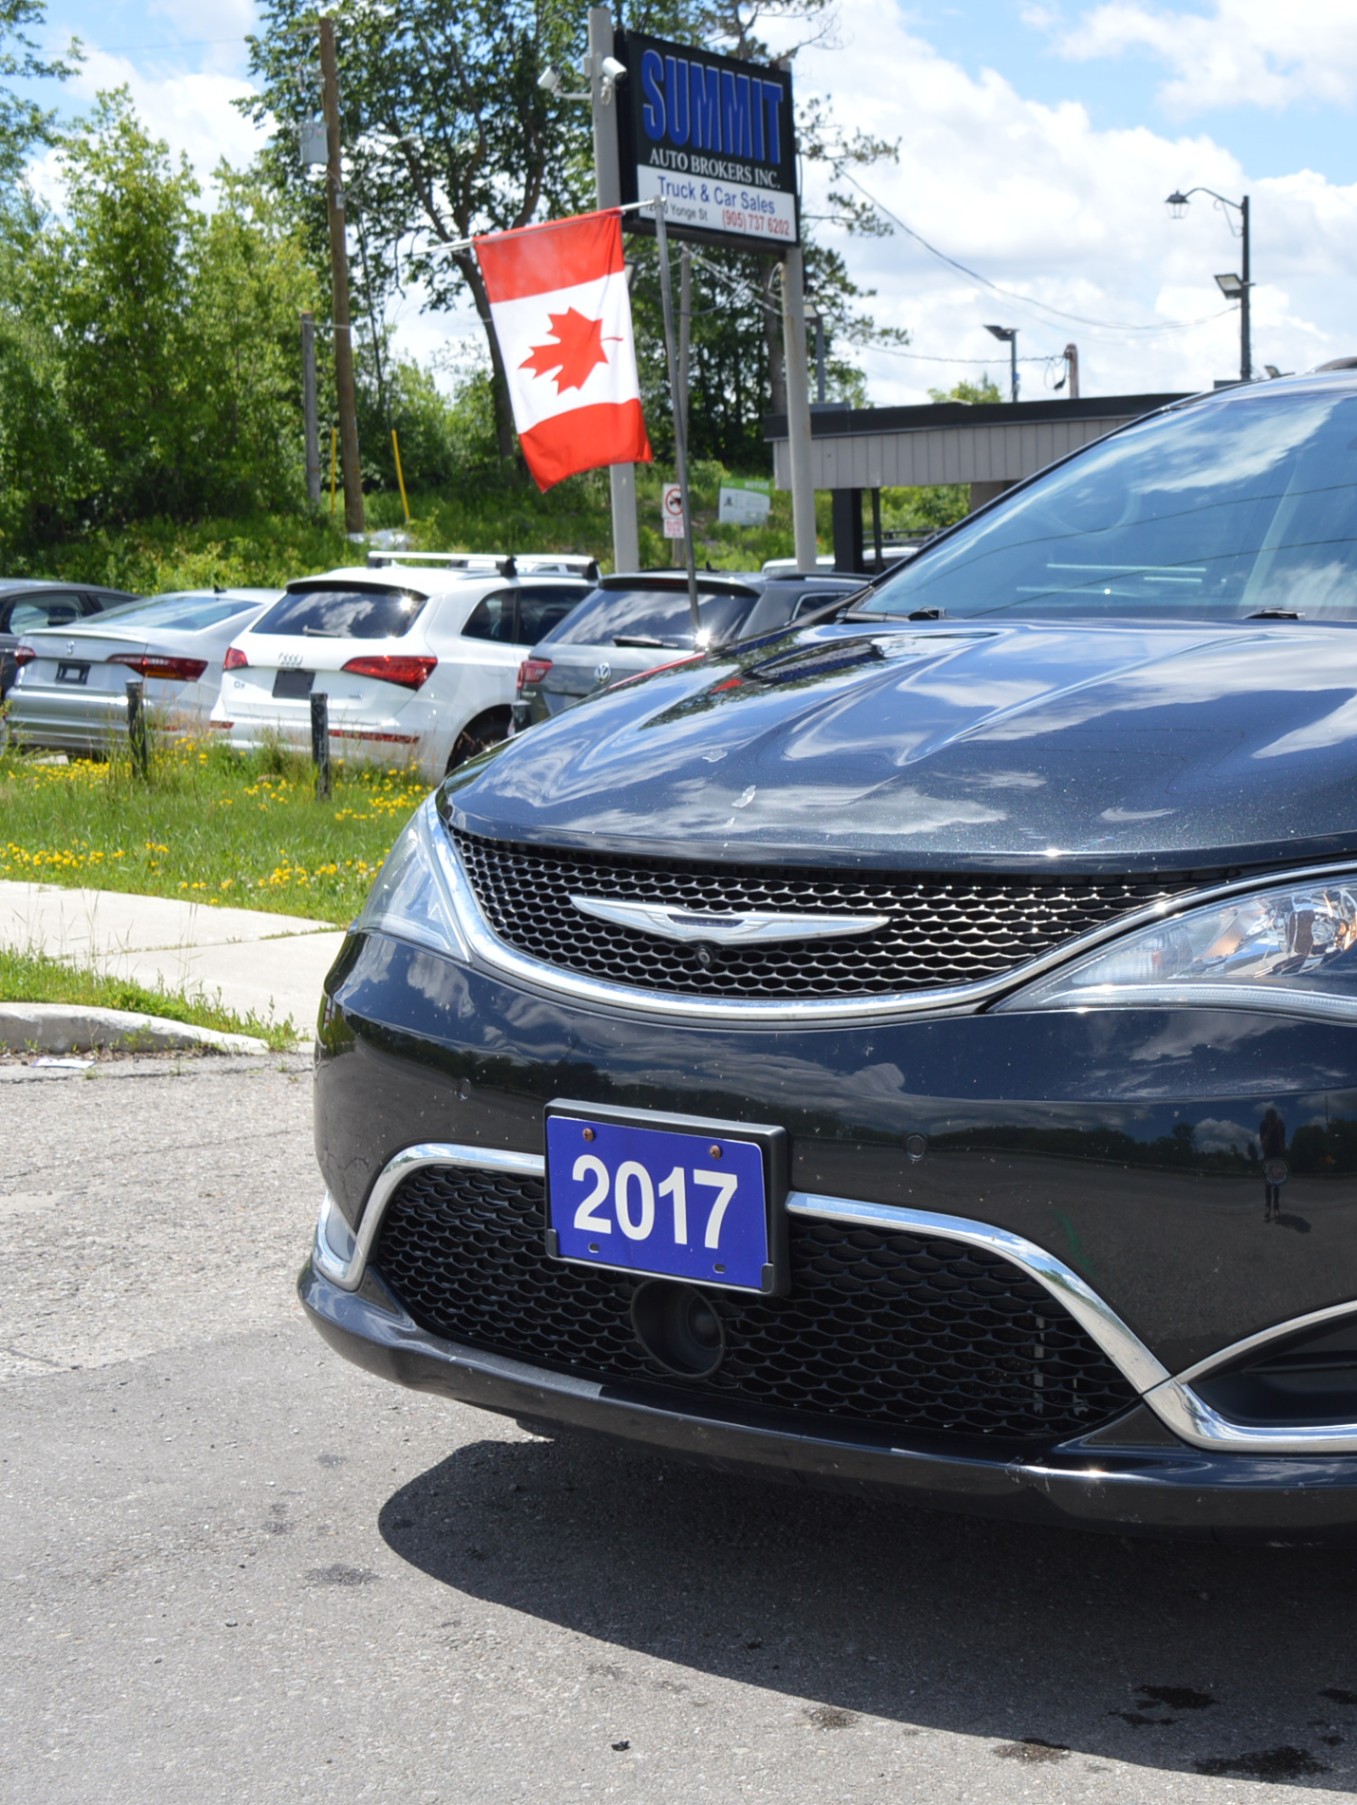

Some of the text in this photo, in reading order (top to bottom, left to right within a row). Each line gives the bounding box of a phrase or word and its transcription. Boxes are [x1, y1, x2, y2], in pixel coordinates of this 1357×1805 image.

[641, 49, 783, 165] SUMMIT
[649, 147, 781, 190] AUTO BROKERS INC.
[657, 175, 775, 214] Truck & Car Sales
[670, 202, 697, 221] Yonge
[698, 207, 708, 221] St
[722, 209, 790, 236] (905) 737 6202
[572, 1154, 738, 1249] 2017
